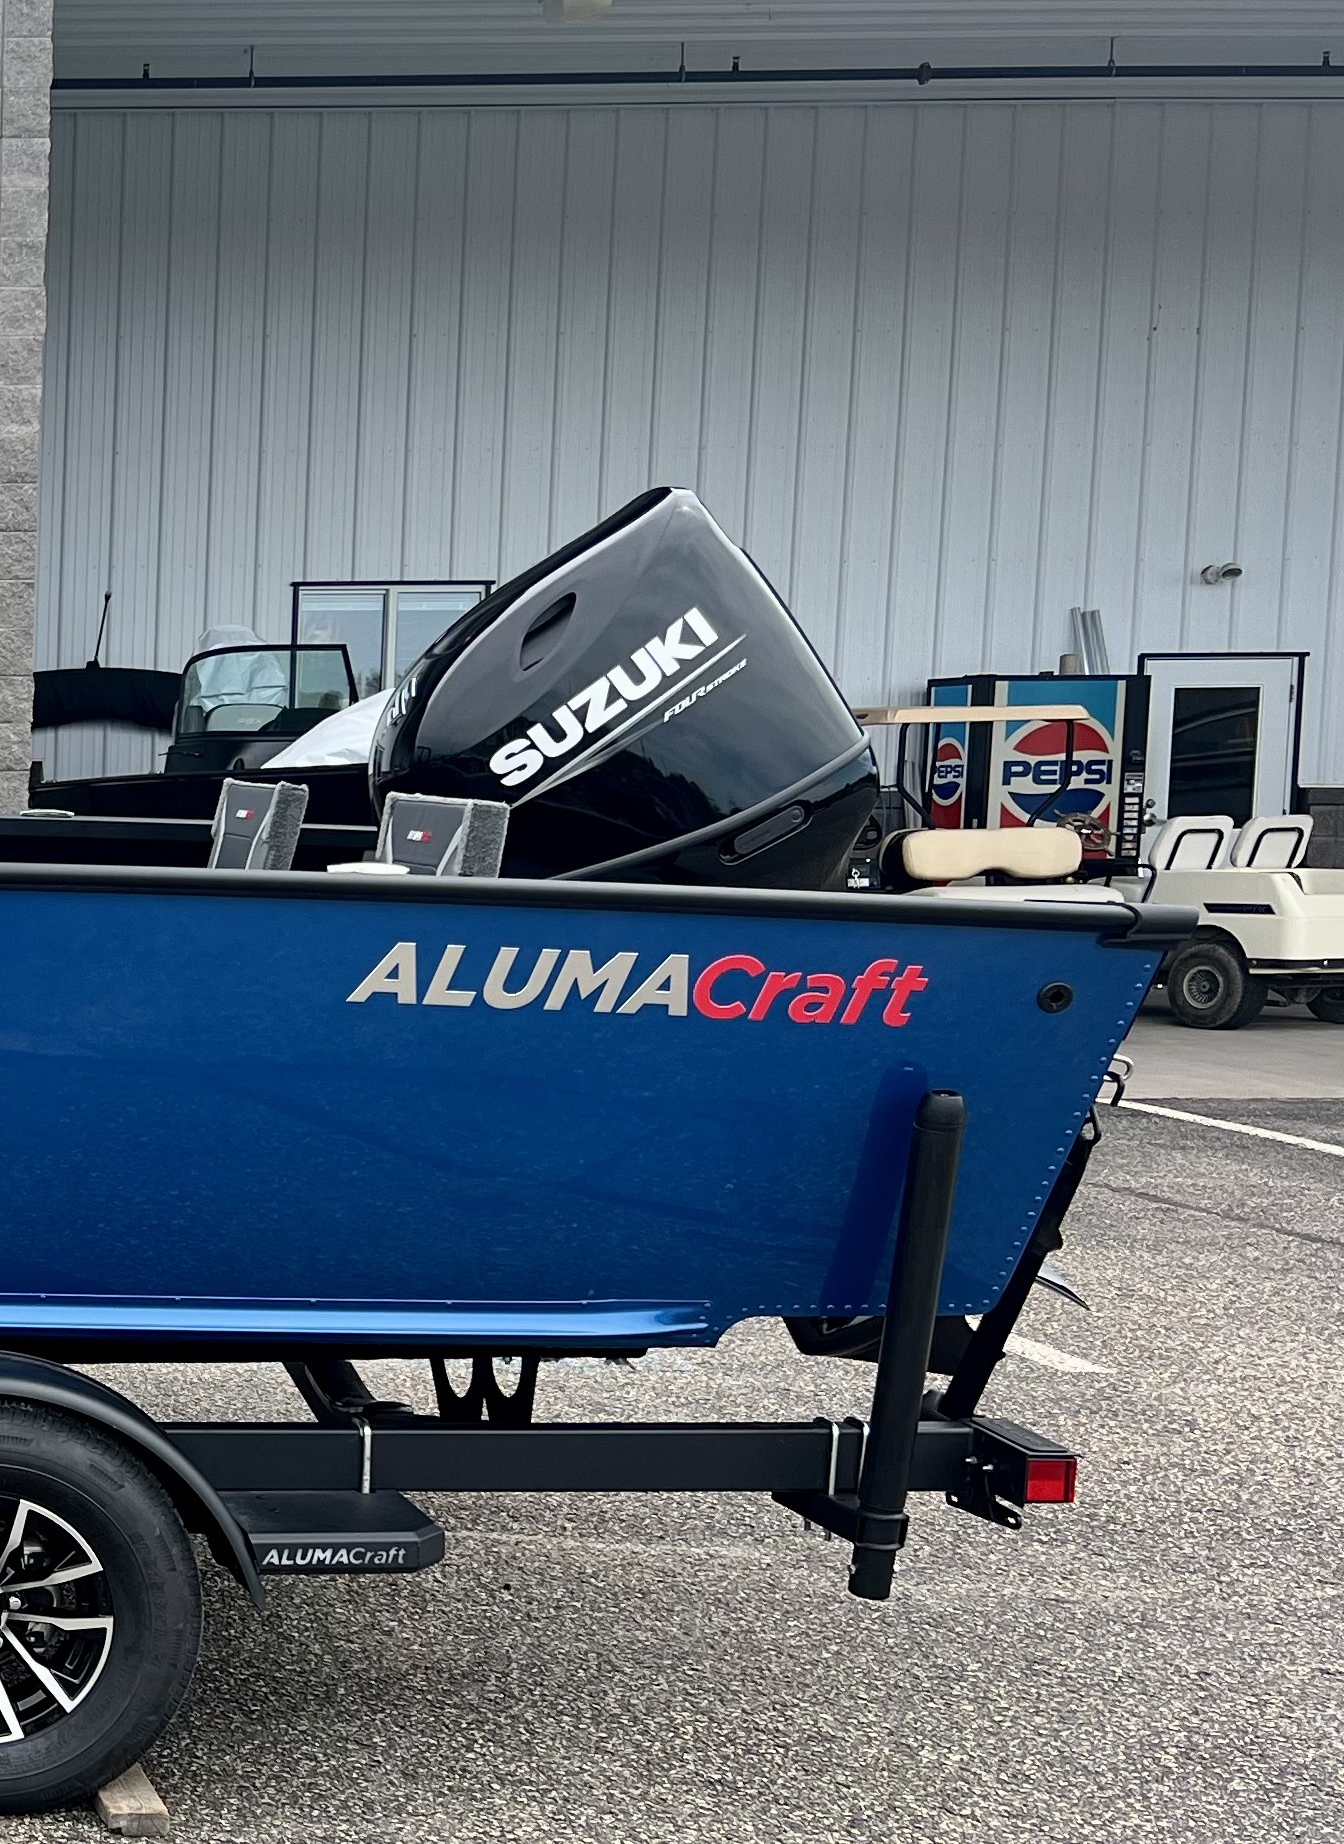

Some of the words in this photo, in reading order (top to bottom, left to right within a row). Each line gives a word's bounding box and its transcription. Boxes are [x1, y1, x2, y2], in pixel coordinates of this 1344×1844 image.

[489, 607, 718, 787] SUZUKI
[1002, 759, 1113, 786] PEPSI
[345, 942, 929, 1028] ALUMACraft
[262, 1547, 406, 1566] ALUMACraft
